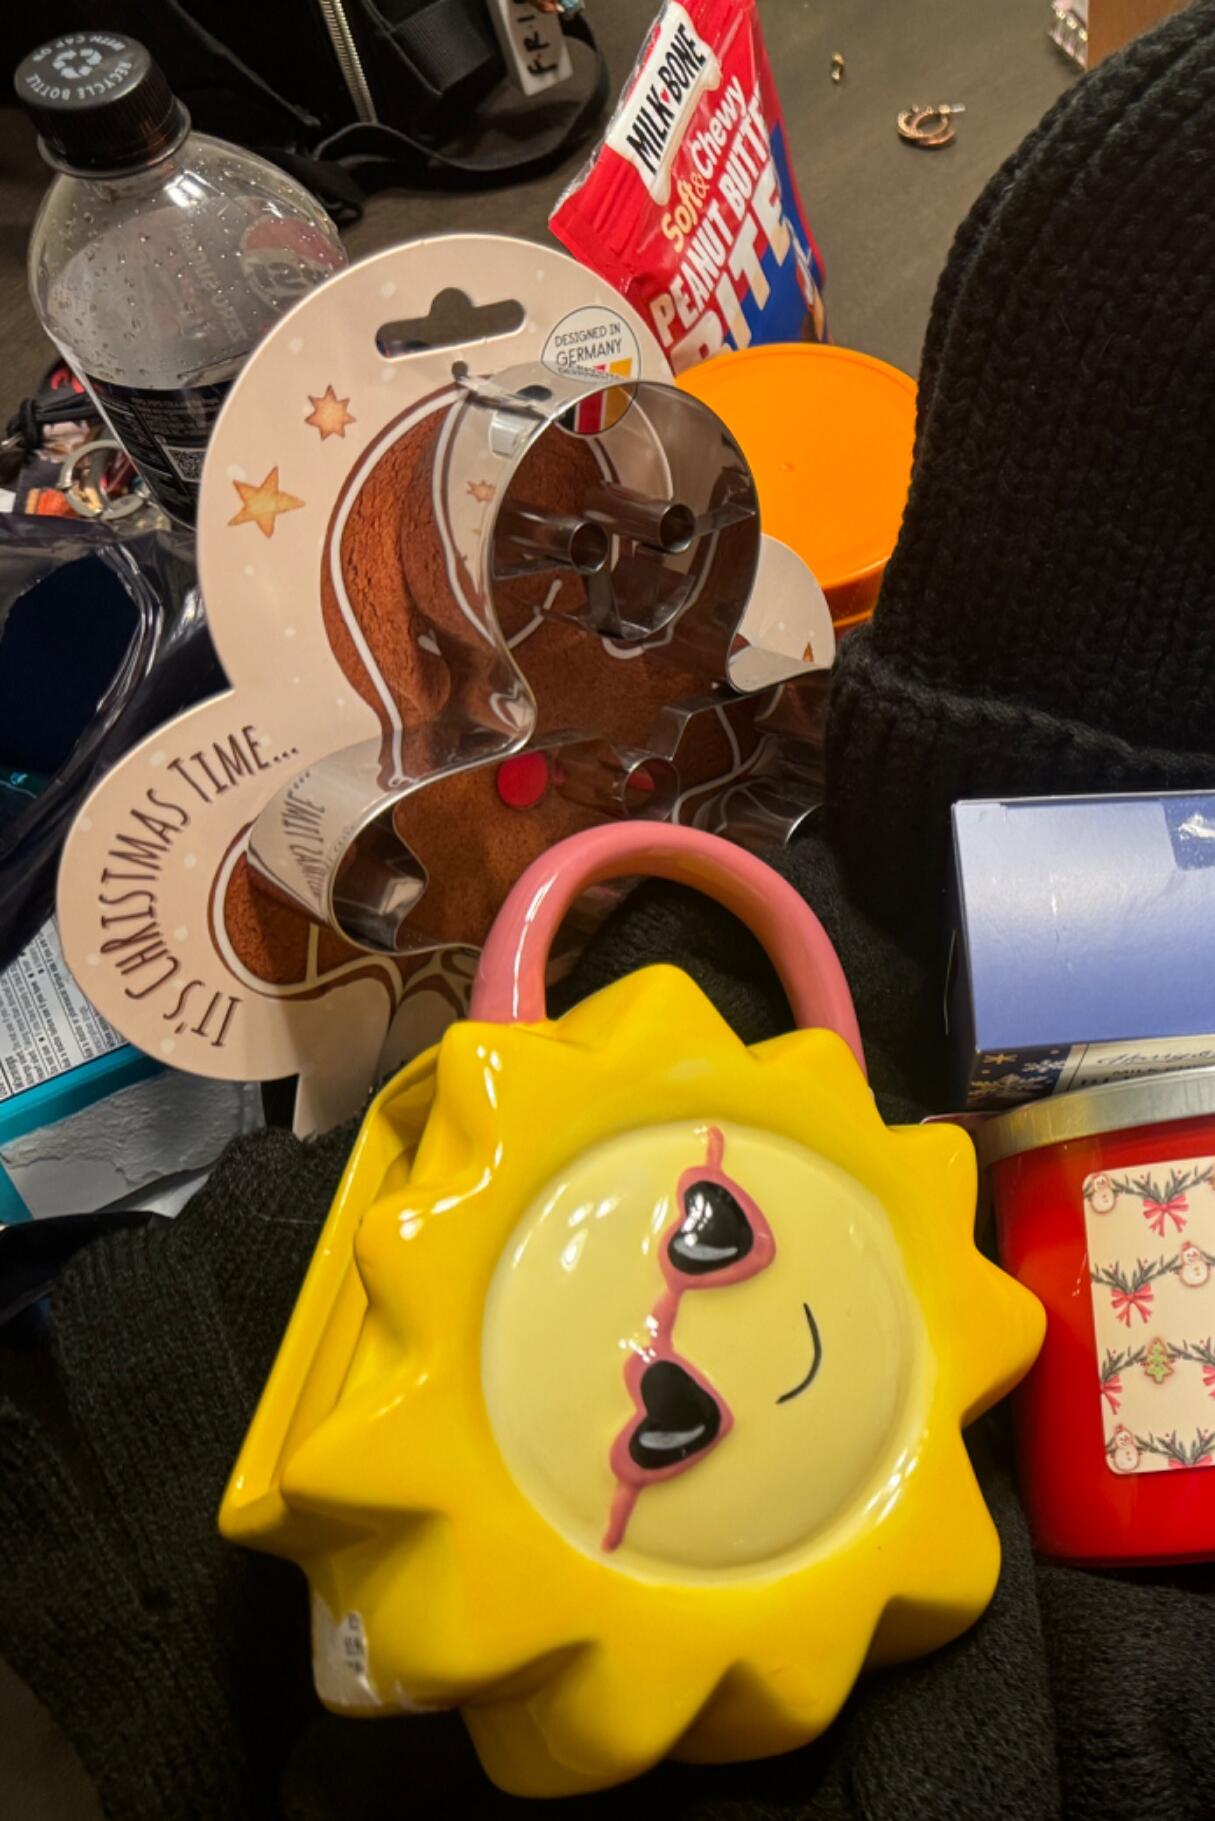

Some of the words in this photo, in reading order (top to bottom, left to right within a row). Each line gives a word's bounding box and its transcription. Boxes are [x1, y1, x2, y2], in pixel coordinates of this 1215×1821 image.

[56, 35, 85, 48] CAP
[25, 73, 71, 100] BOTTLE
[77, 61, 132, 99] RECYCLE
[650, 199, 734, 348] PEANUT
[555, 325, 607, 347] DESIGNED
[609, 323, 621, 336] IN
[556, 338, 622, 367] GERMANY
[98, 788, 191, 1002] CHRISTMAS
[163, 979, 242, 1048] IT'S
